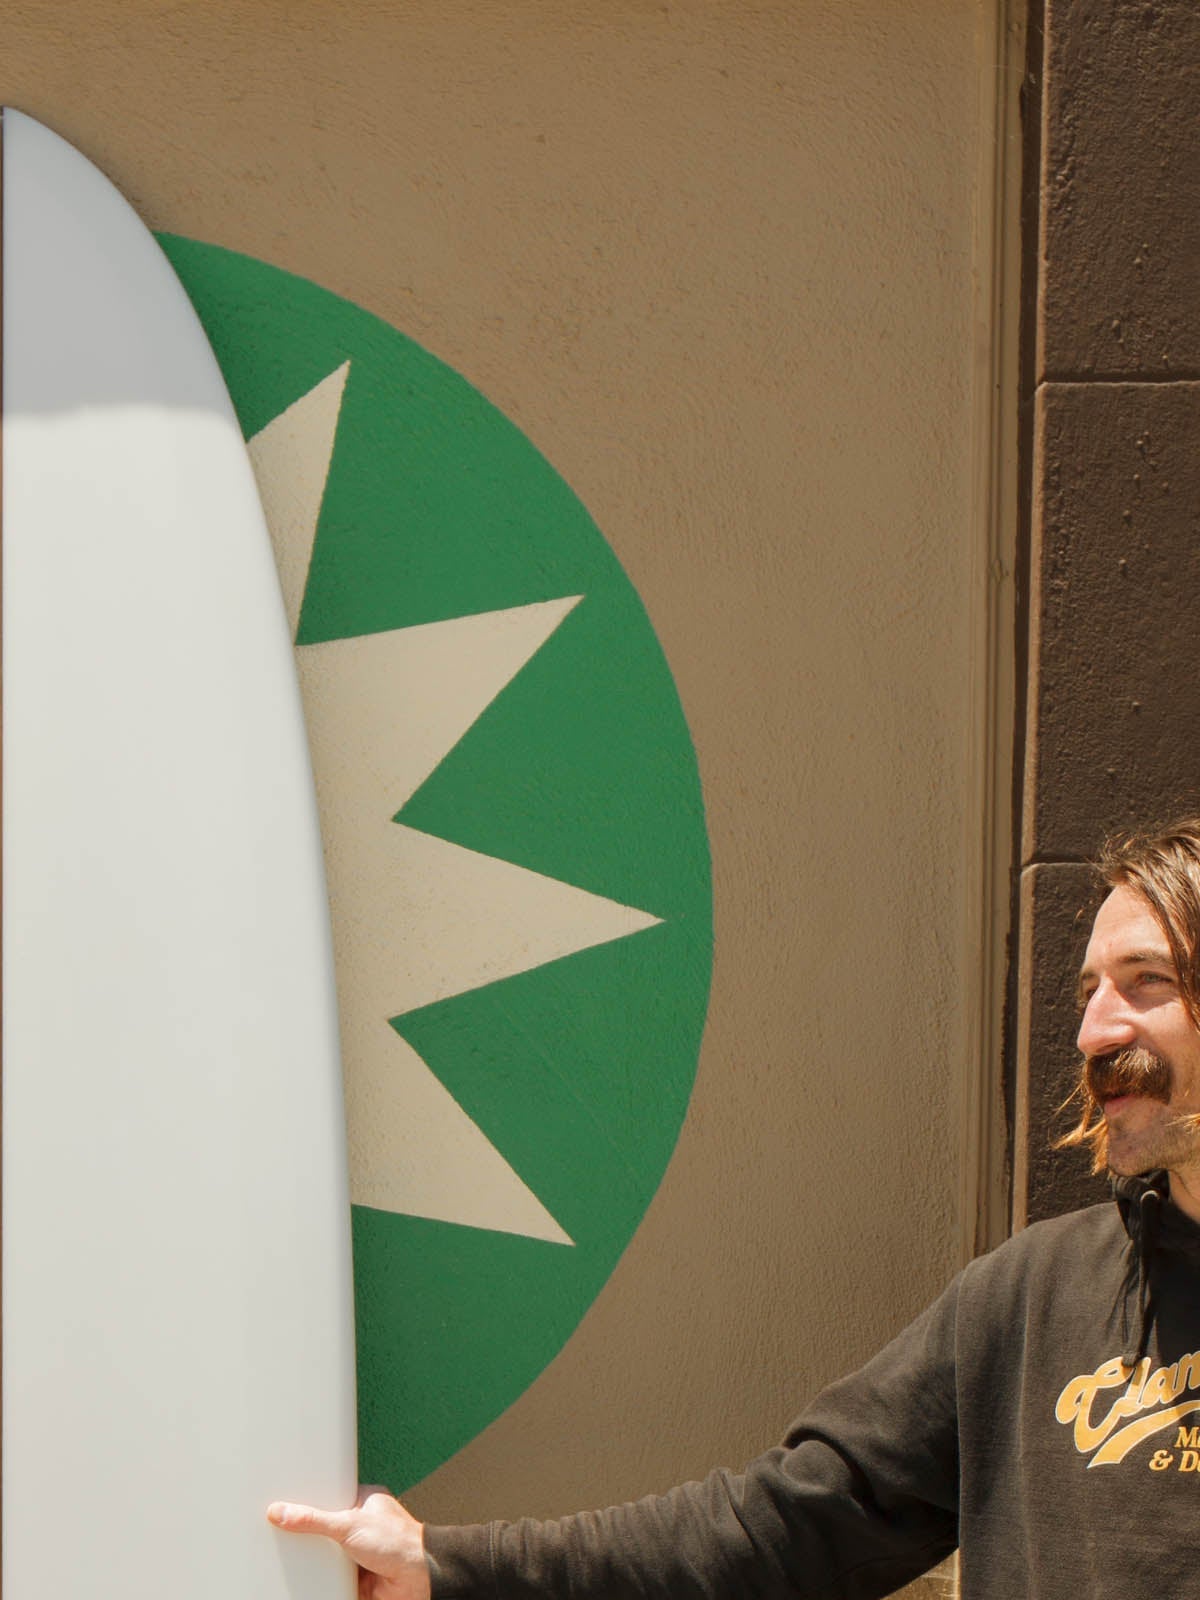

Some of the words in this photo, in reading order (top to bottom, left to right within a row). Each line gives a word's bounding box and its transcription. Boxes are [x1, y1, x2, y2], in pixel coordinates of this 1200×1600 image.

[1174, 1426, 1200, 1448] M
[1149, 1449, 1174, 1471] &
[1178, 1450, 1200, 1472] D
